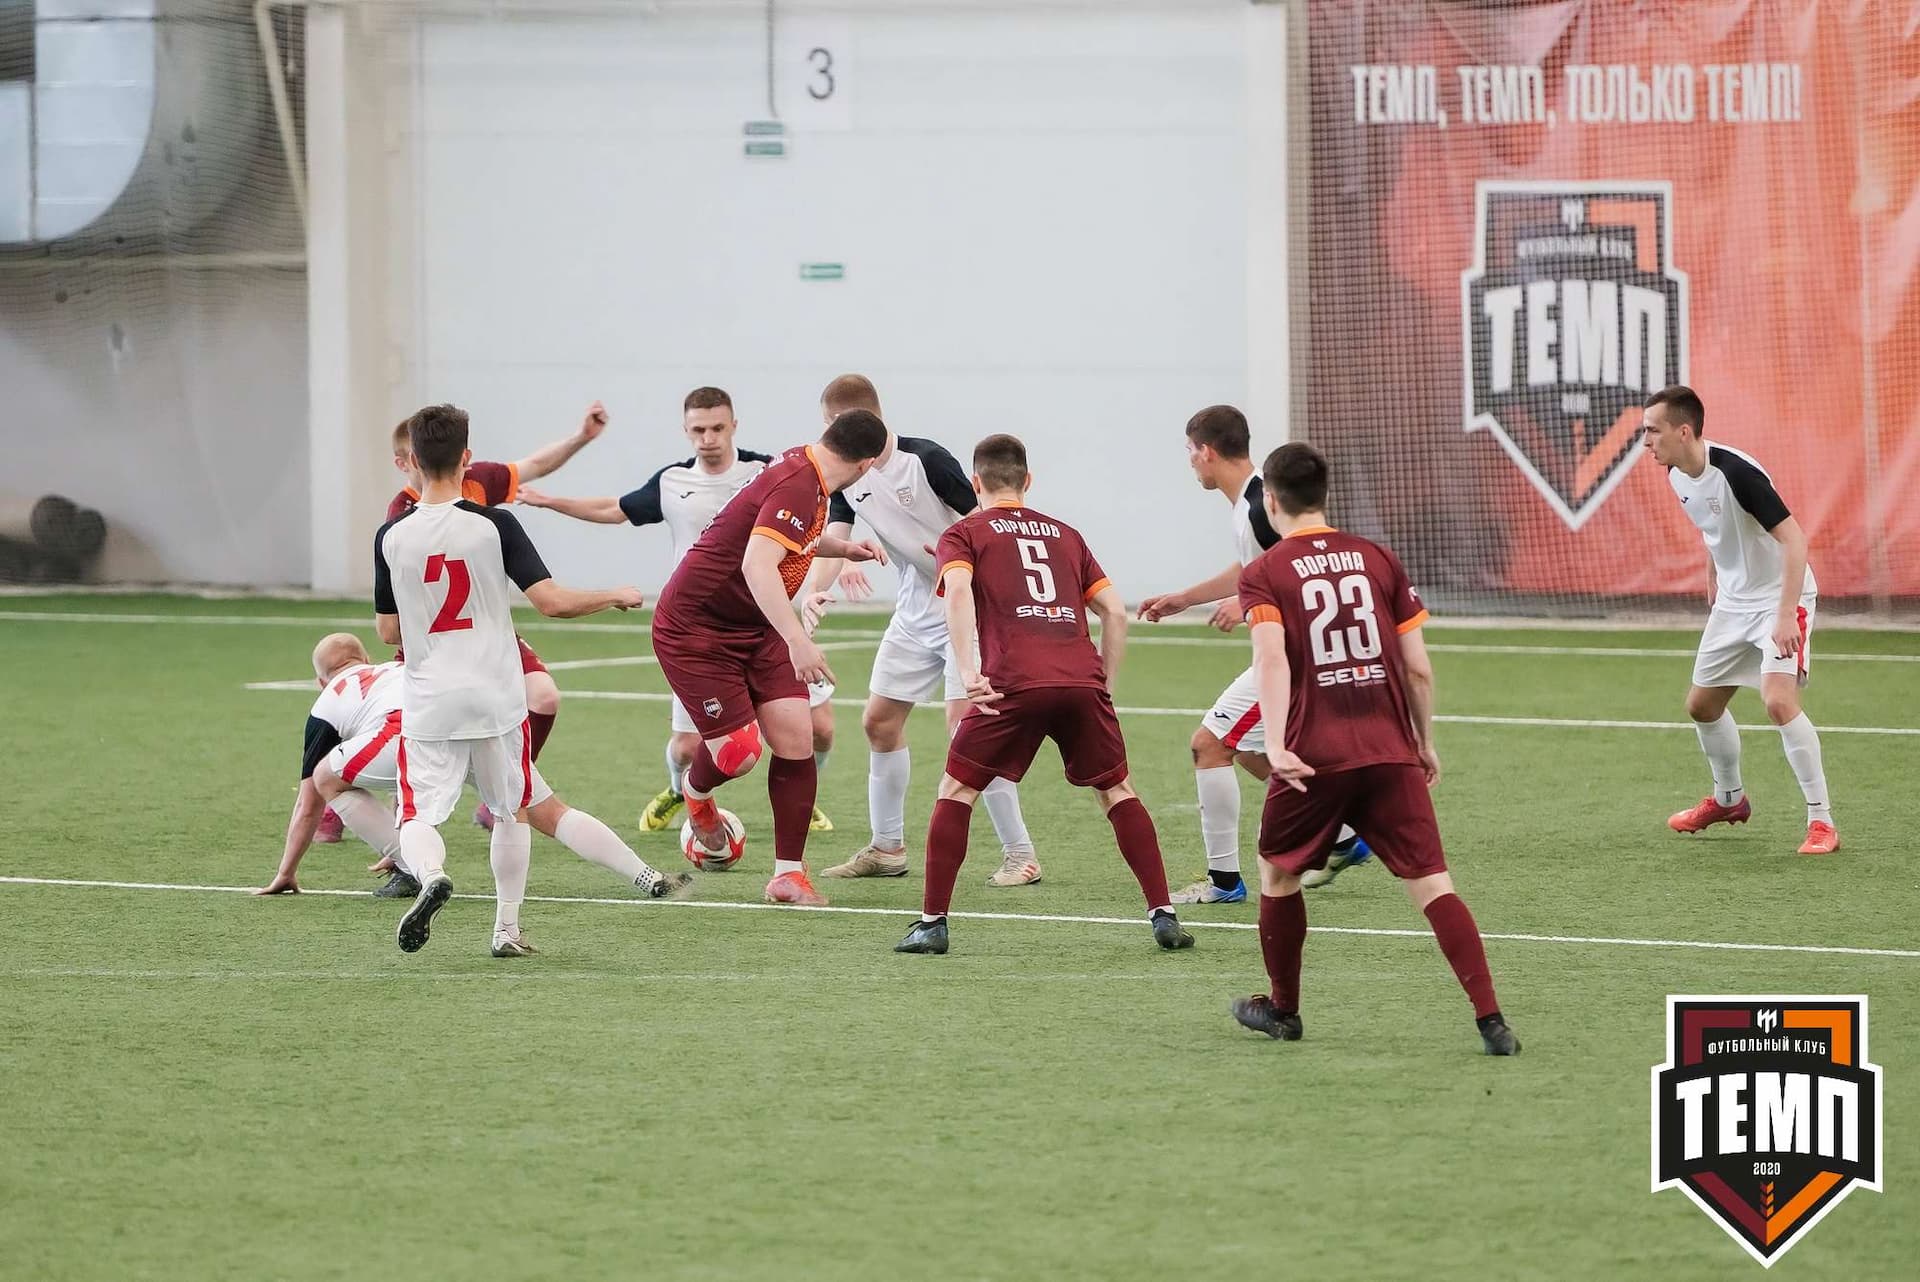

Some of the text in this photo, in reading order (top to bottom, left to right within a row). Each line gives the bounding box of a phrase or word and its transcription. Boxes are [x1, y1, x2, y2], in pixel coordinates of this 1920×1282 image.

[807, 47, 835, 100] 3
[1352, 62, 1802, 129] ТЕМП, ТЕМП, ТОЛЬКО ТЕМП!
[1484, 279, 1666, 393] ТЕМП
[989, 518, 1061, 538] БОРИСОВ
[423, 553, 473, 634] 2
[1016, 538, 1057, 603] 5
[1291, 551, 1365, 579] ВОРОНА
[1016, 605, 1076, 619] SEUS
[1301, 574, 1382, 666] 23
[1317, 664, 1386, 687] SEUS
